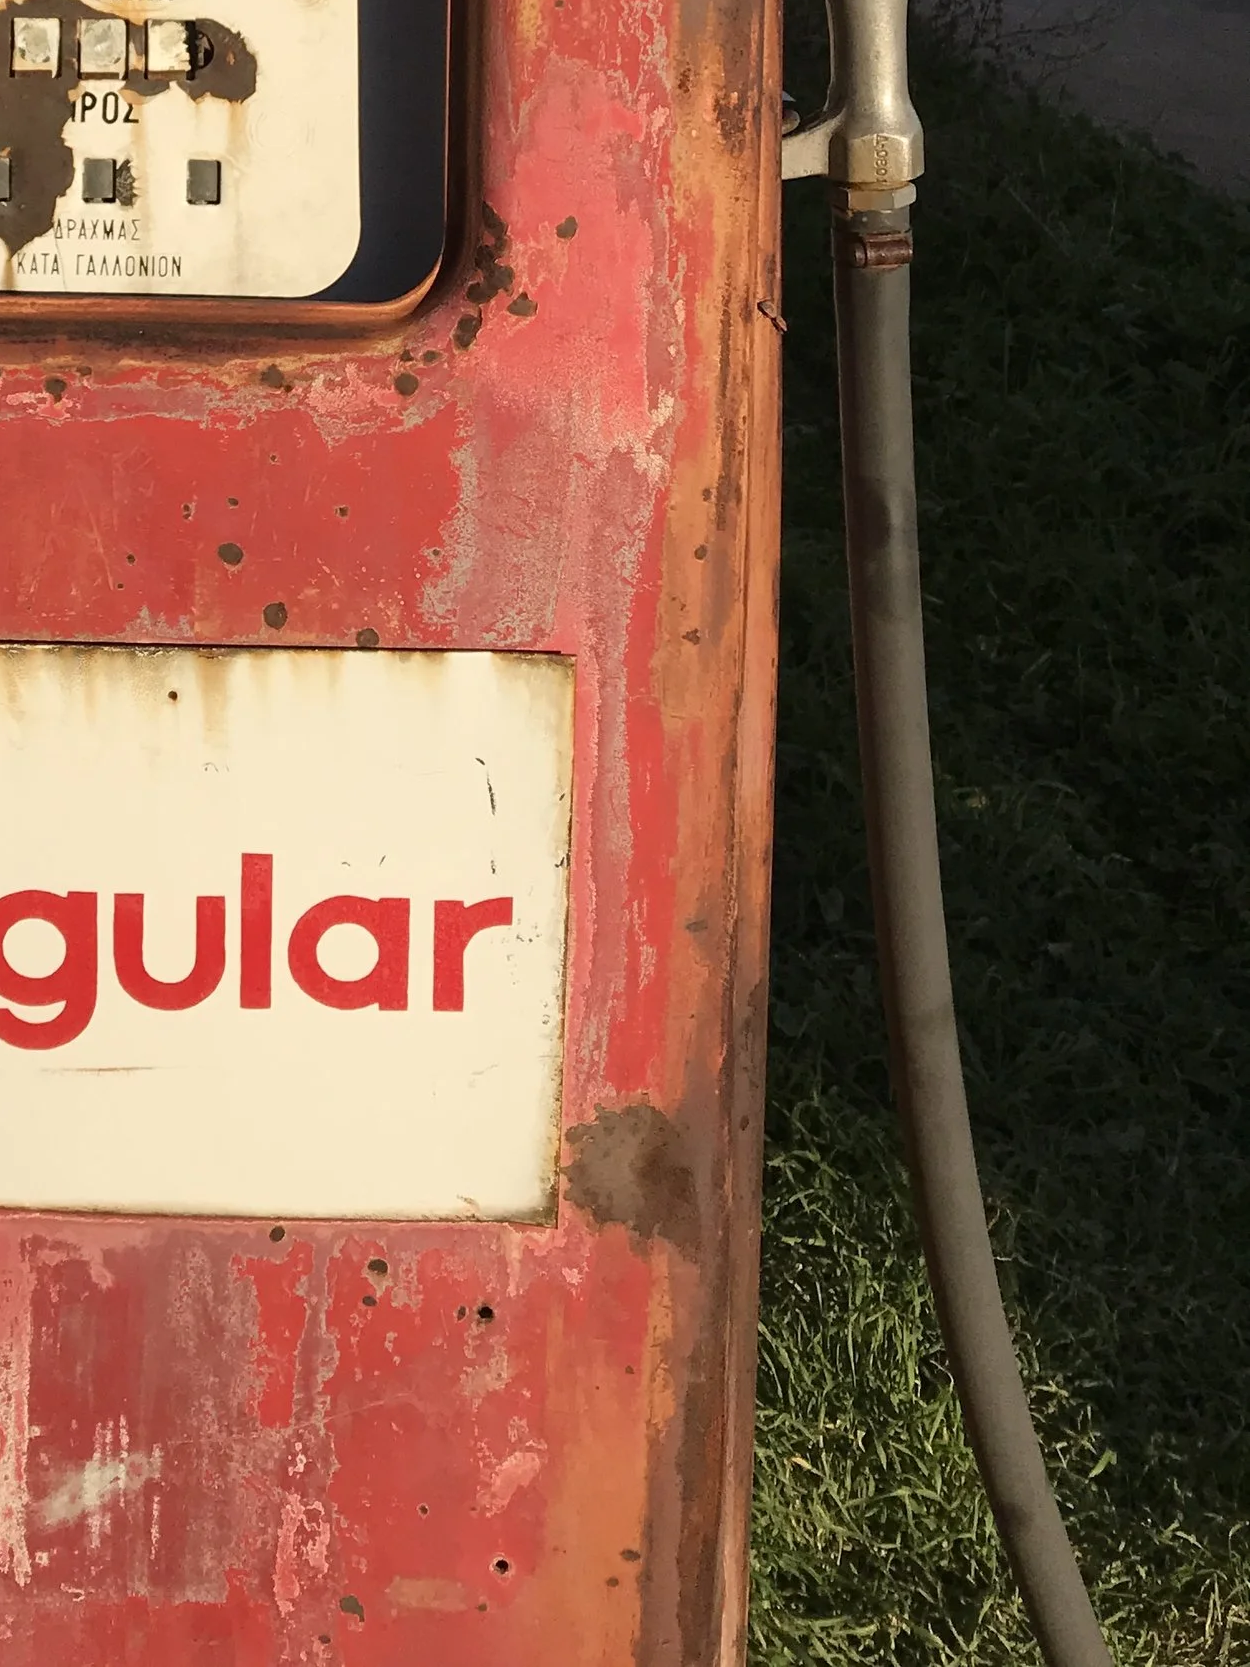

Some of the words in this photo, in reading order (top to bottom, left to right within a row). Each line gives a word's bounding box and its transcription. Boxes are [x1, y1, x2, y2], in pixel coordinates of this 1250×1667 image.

[71, 91, 139, 124] ΡΟΣ
[54, 218, 141, 241] ΔΡΑΧΜΑΣ
[17, 252, 60, 275] ΚΑΤΑ
[76, 254, 182, 277] ΓΑΛΛΟΝΙΟΝ
